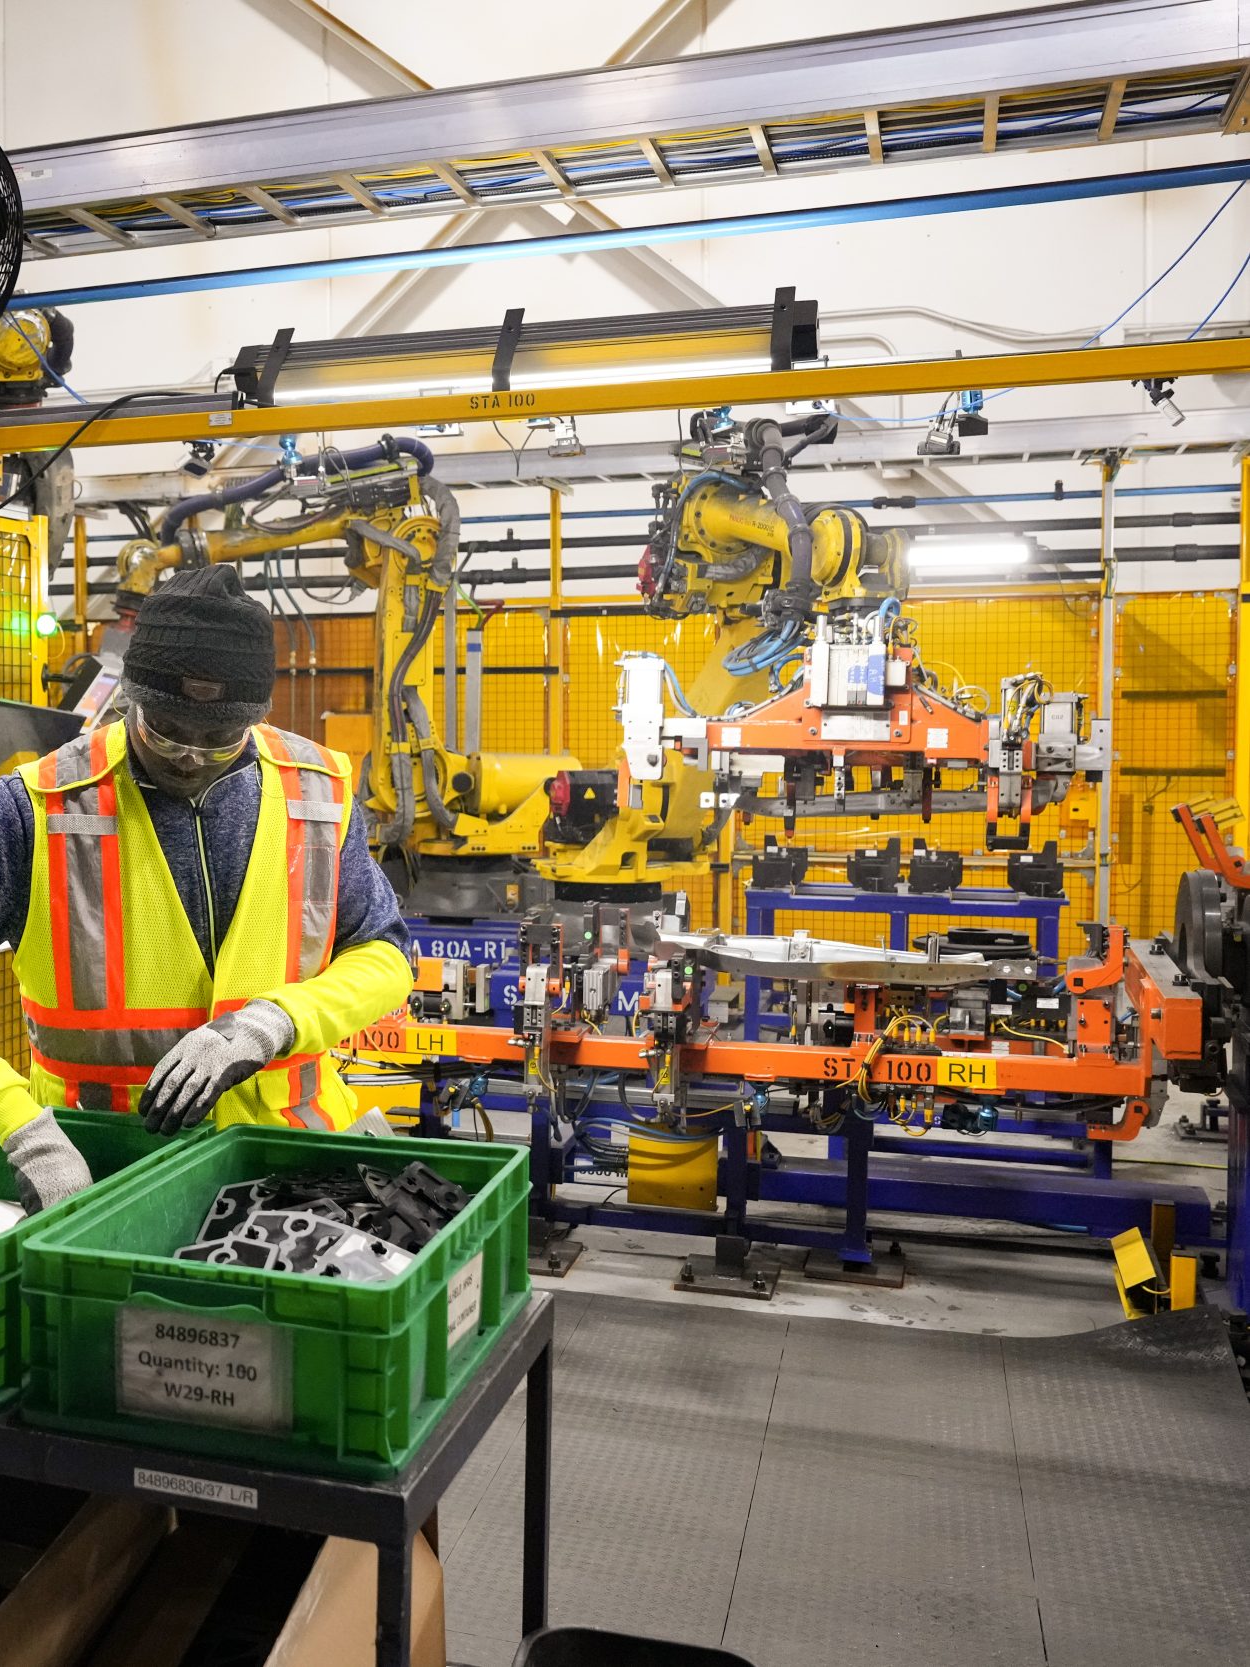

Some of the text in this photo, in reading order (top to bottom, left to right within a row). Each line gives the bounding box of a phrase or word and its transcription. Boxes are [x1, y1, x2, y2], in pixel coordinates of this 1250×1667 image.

[470, 393, 535, 410] STA 100
[416, 1033, 443, 1052] LH
[887, 1060, 932, 1083] 100
[948, 1063, 986, 1084] RH
[155, 1323, 240, 1349] 84896837
[138, 1350, 257, 1382] Quantity: 100
[164, 1382, 235, 1407] W29-RH
[138, 1471, 254, 1504] 84896836/37 L/R
